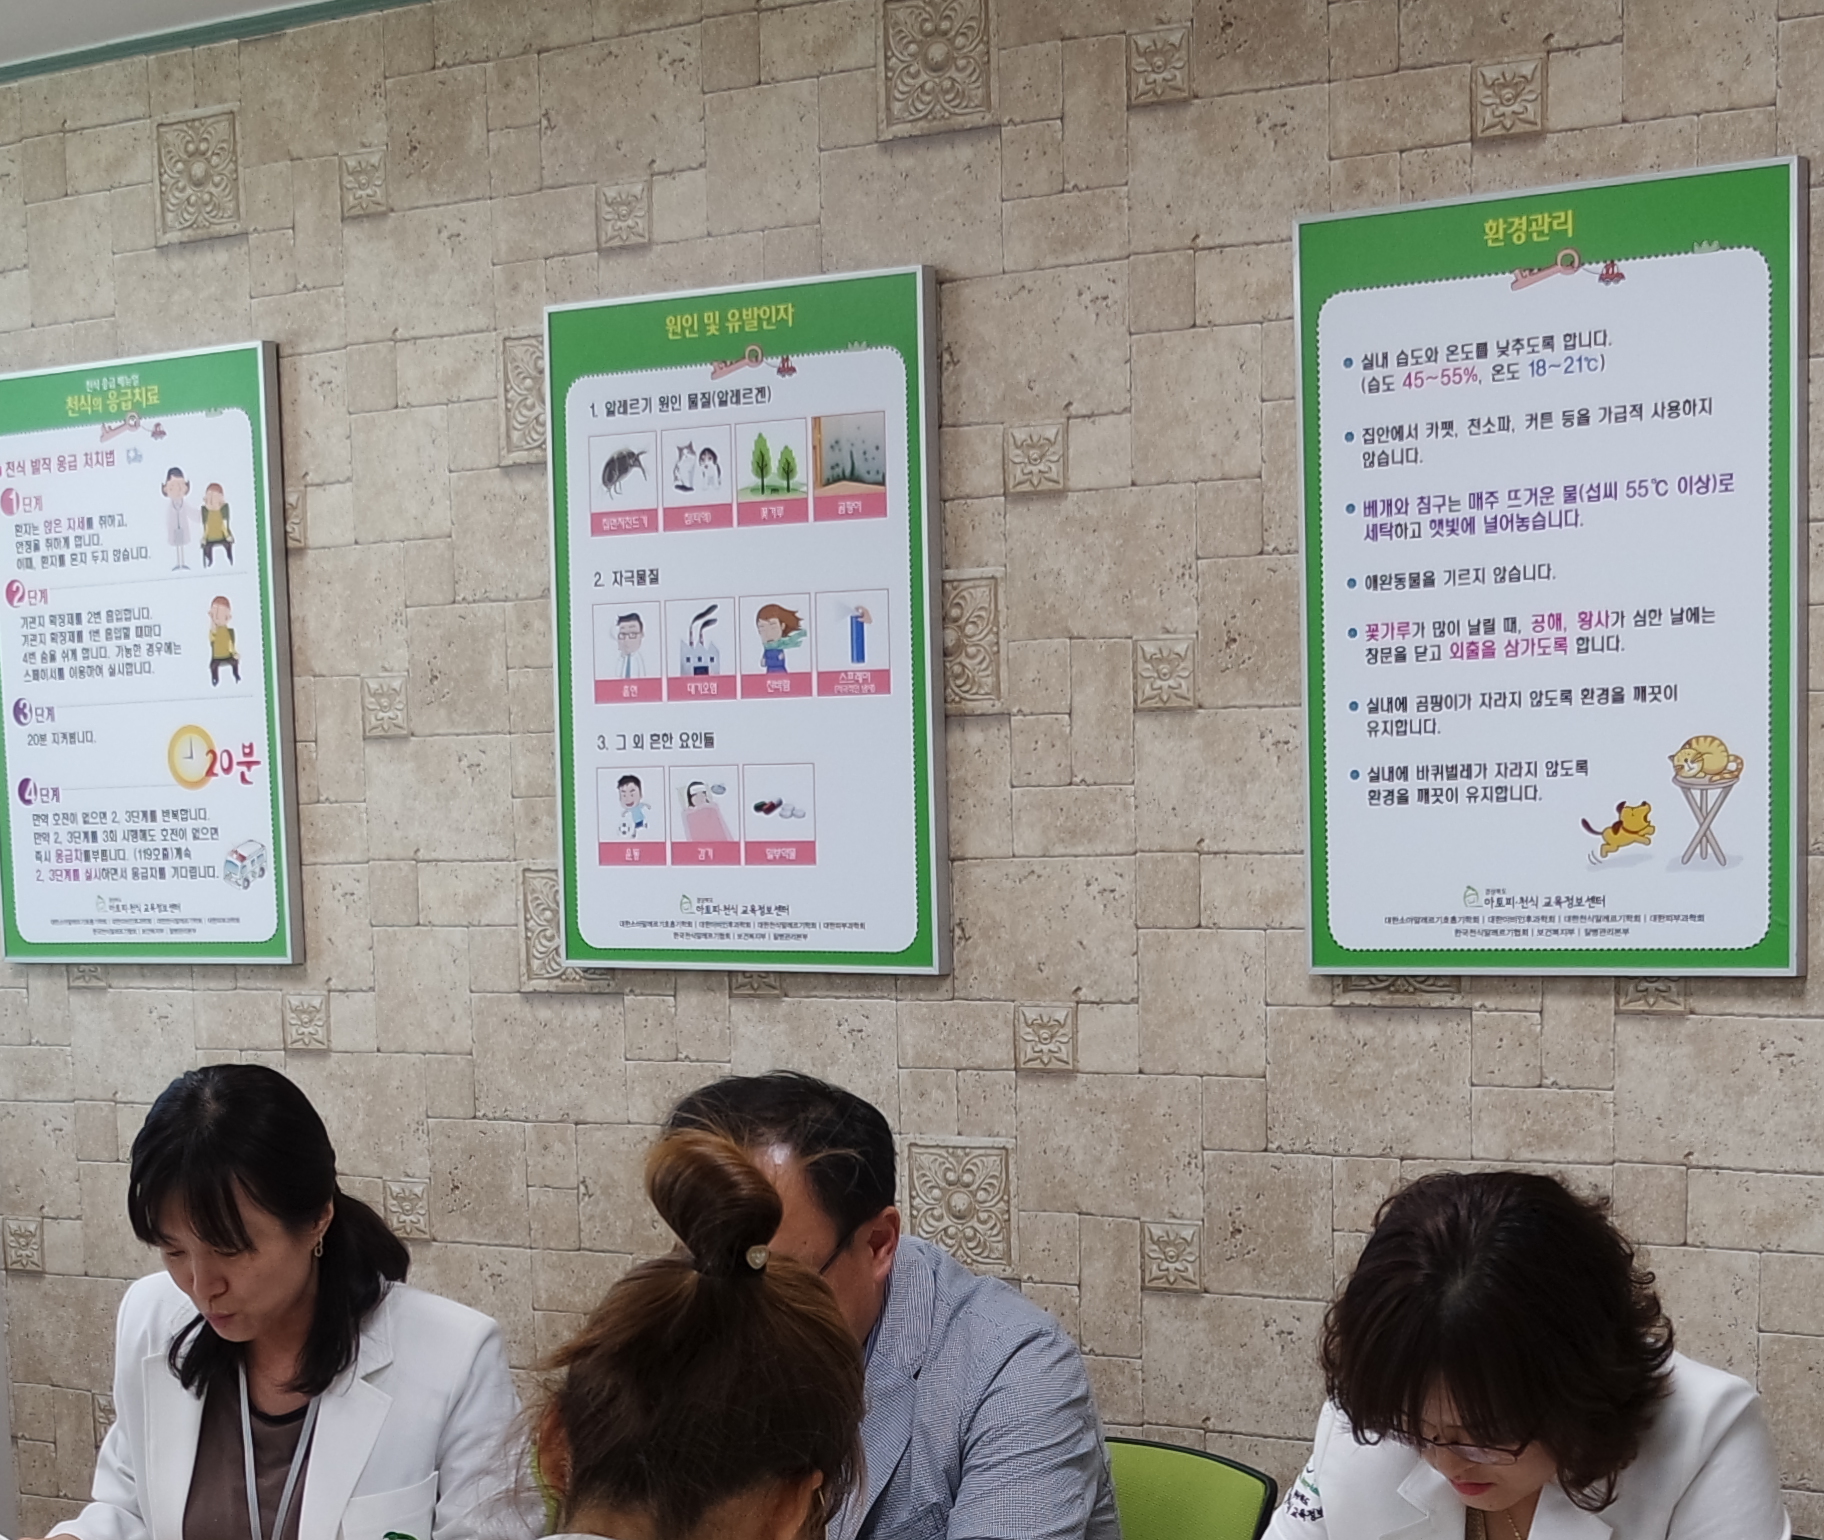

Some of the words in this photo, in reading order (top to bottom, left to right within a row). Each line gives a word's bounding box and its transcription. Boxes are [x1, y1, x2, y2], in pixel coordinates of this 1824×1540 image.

[1484, 210, 1572, 246] 환경관리
[666, 313, 698, 339] 원인
[704, 311, 719, 335] 및
[725, 303, 794, 333] 유발인자
[1362, 352, 1388, 370] 실내
[1396, 346, 1438, 367] 습도와
[1446, 342, 1488, 362] 온도를
[1496, 335, 1554, 357] 낮추도록
[1563, 329, 1611, 351] 합니다.
[1362, 375, 1395, 394] (습도
[1492, 363, 1519, 382] 온도
[66, 394, 102, 416] 천식의
[107, 386, 160, 413] 응급치료
[605, 397, 652, 417] 알레르기
[659, 394, 681, 412] 원인
[1362, 423, 1418, 445] 집안에서
[1468, 415, 1514, 435] 천소파,
[1525, 412, 1553, 430] 커튼
[1562, 408, 1590, 428] 등을
[1599, 403, 1642, 424] 가급적
[1651, 397, 1712, 419] 사용하지
[30, 457, 51, 475] 발작
[57, 454, 77, 472] 응급
[84, 450, 115, 468] 처치법
[1363, 447, 1423, 468] 않습니다.
[1364, 497, 1409, 518] 베개와
[1417, 495, 1461, 515] 침구는
[1469, 491, 1499, 510] 매주
[1507, 486, 1554, 508] 뜨거운
[1564, 481, 1617, 504] 물(섭씨
[1678, 473, 1734, 495] 이상)로
[1364, 522, 1421, 541] 세탁하고
[1429, 516, 1475, 537] 햇빛에
[1484, 508, 1583, 534] 널어놓습니다.
[613, 568, 659, 586] 자극물질
[1365, 571, 1435, 591] 애완동물을
[1444, 567, 1485, 586] 기르지
[1493, 563, 1555, 584] 않습니다.
[1366, 621, 1425, 641] 꽃가루가
[1432, 617, 1461, 638] 많이
[1468, 618, 1495, 636] 날릴
[1504, 617, 1521, 634] 때,
[1532, 613, 1566, 633] 공해,
[1578, 610, 1625, 630] 황사가
[1633, 608, 1662, 627] 심한
[1670, 607, 1715, 625] 날에는
[1366, 646, 1406, 665] 창문을
[1414, 644, 1441, 662] 닫고
[1450, 640, 1496, 660] 외출을
[1504, 637, 1568, 658] 삼가도록
[1576, 634, 1624, 654] 합니다.
[1367, 696, 1407, 714] 실내에
[1416, 693, 1471, 712] 곰팡이가
[1479, 691, 1521, 709] 자라지
[1530, 689, 1572, 707] 않도록
[1581, 686, 1624, 705] 환경을
[1633, 684, 1677, 703] 깨끗이
[597, 735, 608, 750] 3.
[616, 734, 626, 750] 그
[633, 734, 644, 750] 외
[650, 732, 673, 749] 흔한
[679, 732, 714, 748] 요인들
[1367, 718, 1440, 737] 유지합니다.
[205, 742, 261, 784] 20분
[1368, 766, 1408, 783] 실내에
[1417, 763, 1487, 781] 바퀴벌레가
[1495, 761, 1537, 779] 자라지
[1545, 760, 1588, 777] 않도록
[1368, 788, 1409, 806] 환경을
[1417, 787, 1458, 804] 깨끗이
[1466, 784, 1542, 803] 유지합니다.
[1543, 895, 1605, 908] 교육정보센터
